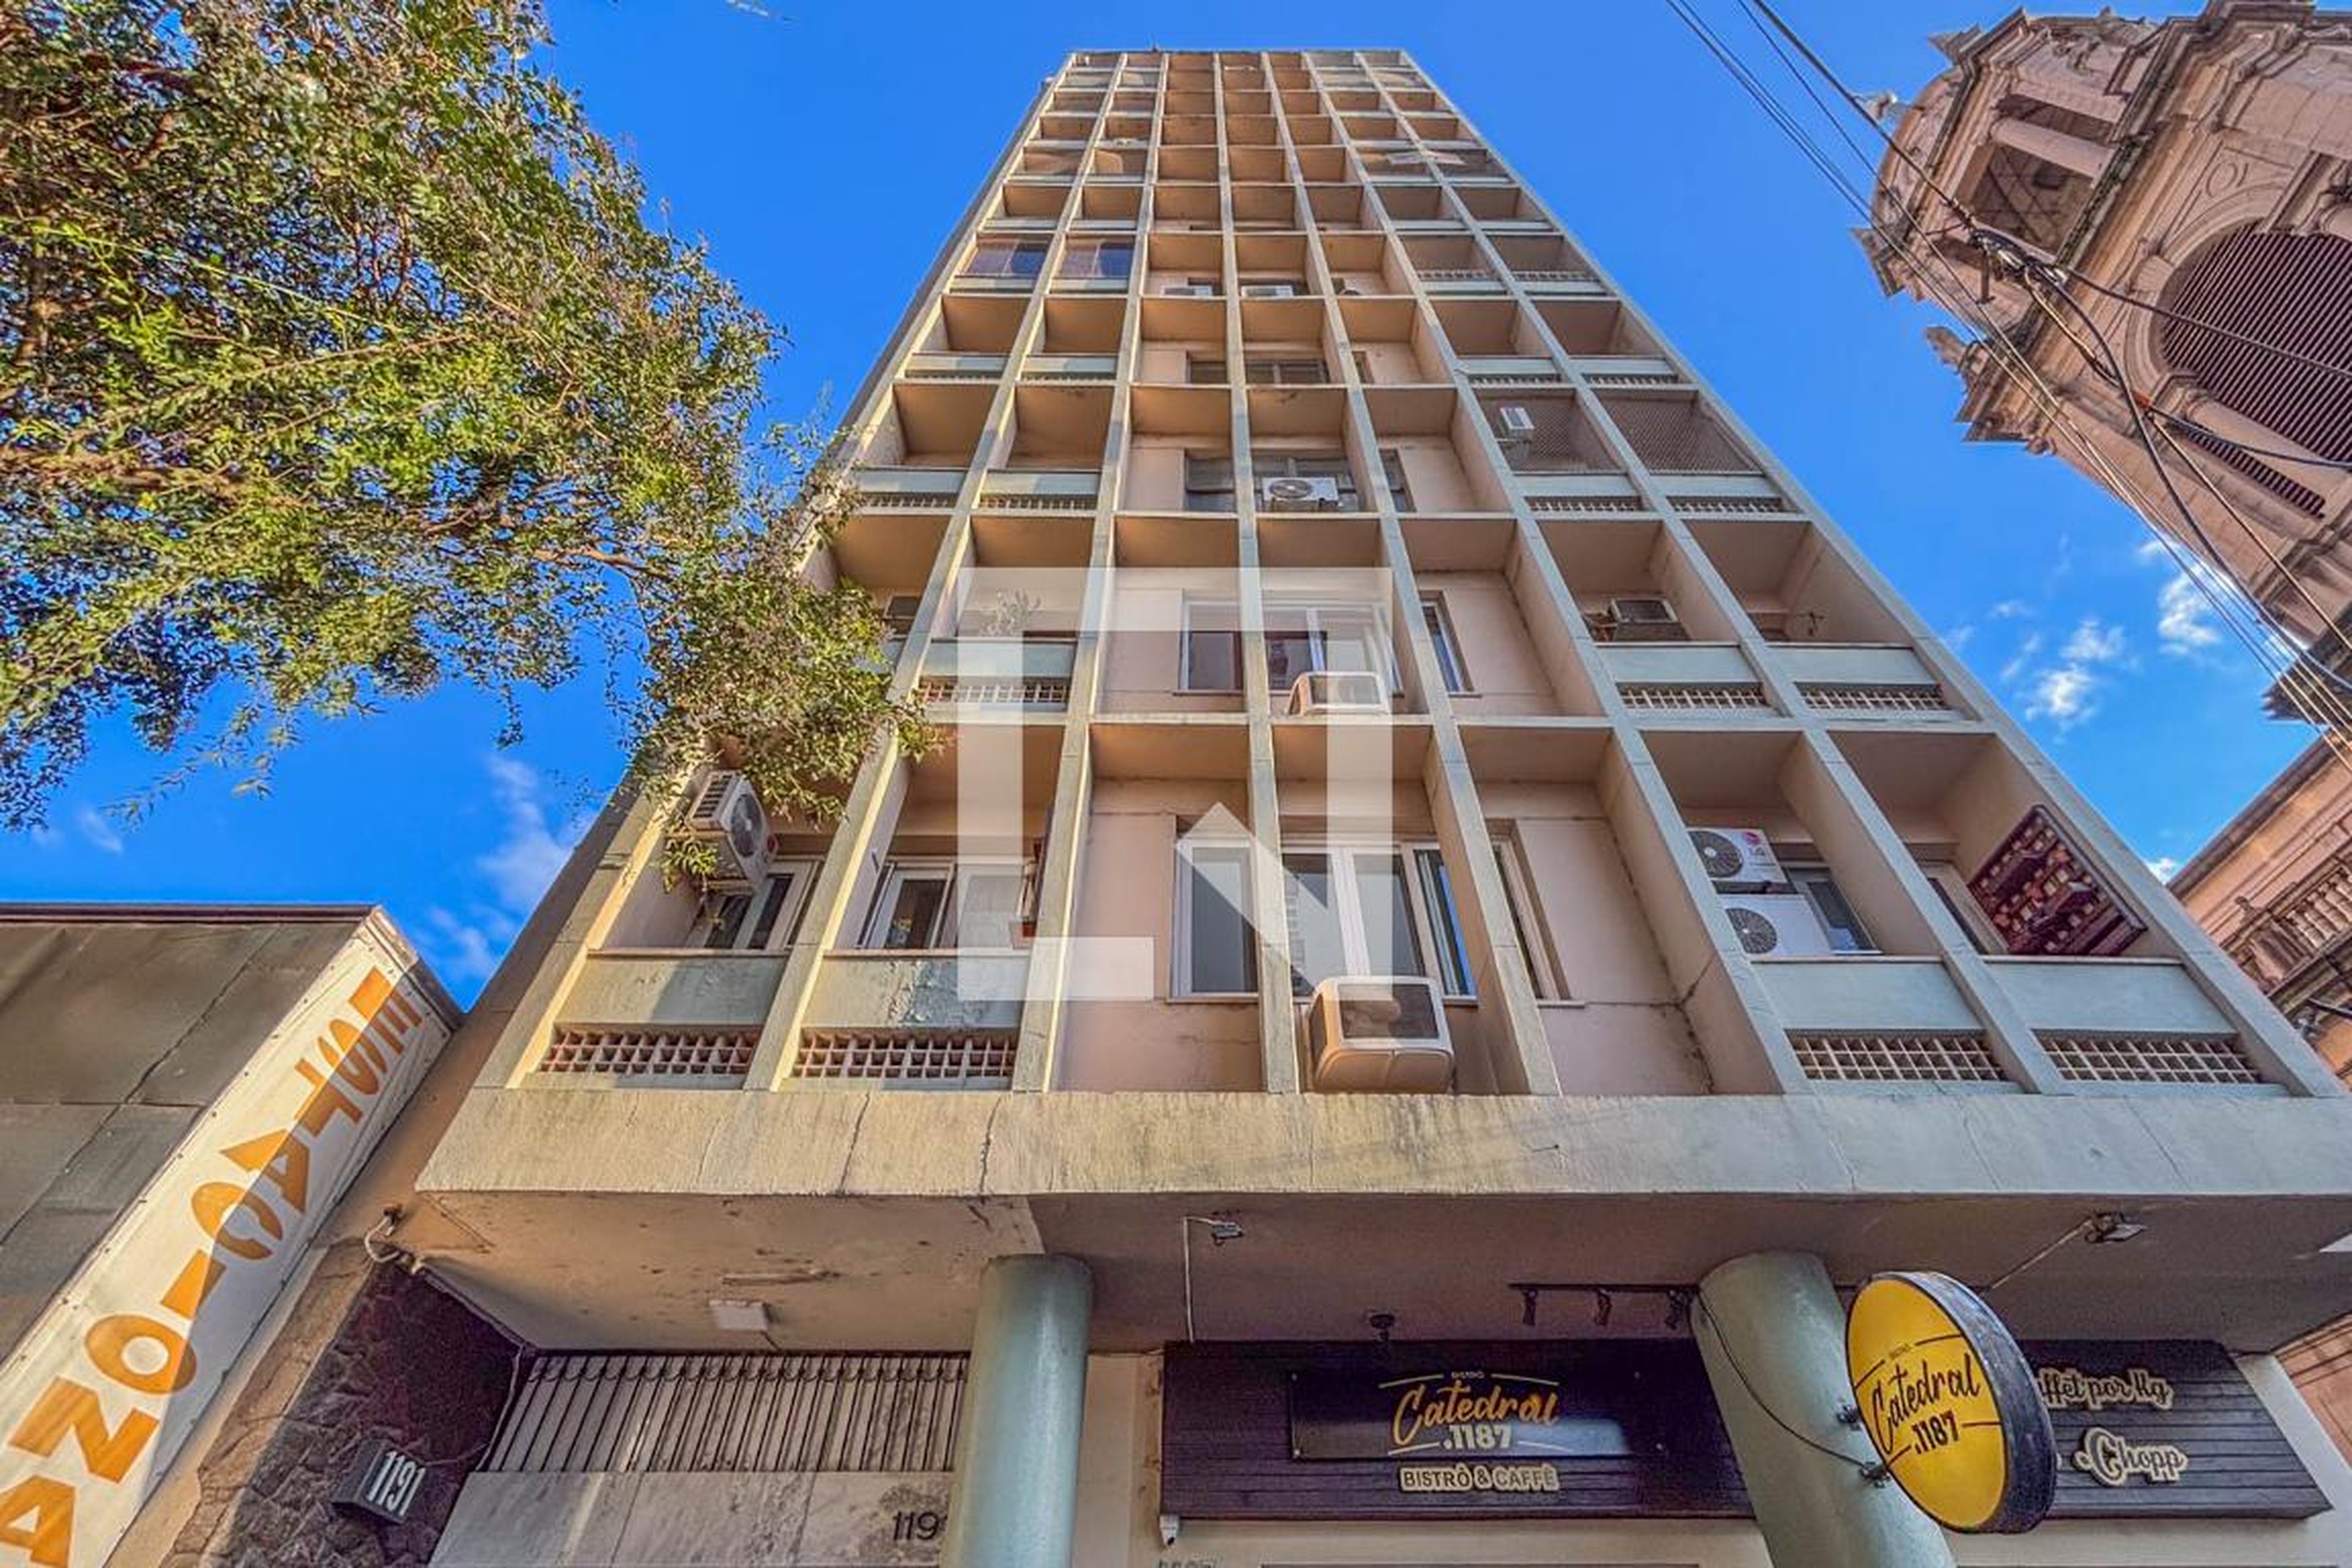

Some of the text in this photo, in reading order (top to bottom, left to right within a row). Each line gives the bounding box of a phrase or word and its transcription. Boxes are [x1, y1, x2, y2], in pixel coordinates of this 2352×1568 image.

[1393, 1380, 1559, 1446] Catedral
[1872, 1352, 1980, 1455] Catedral
[2088, 1379, 2132, 1404] por
[368, 1450, 426, 1516] 1191
[1477, 1468, 1490, 1487] &
[2075, 1430, 2184, 1483] Chopp
[892, 1510, 948, 1541] 119
